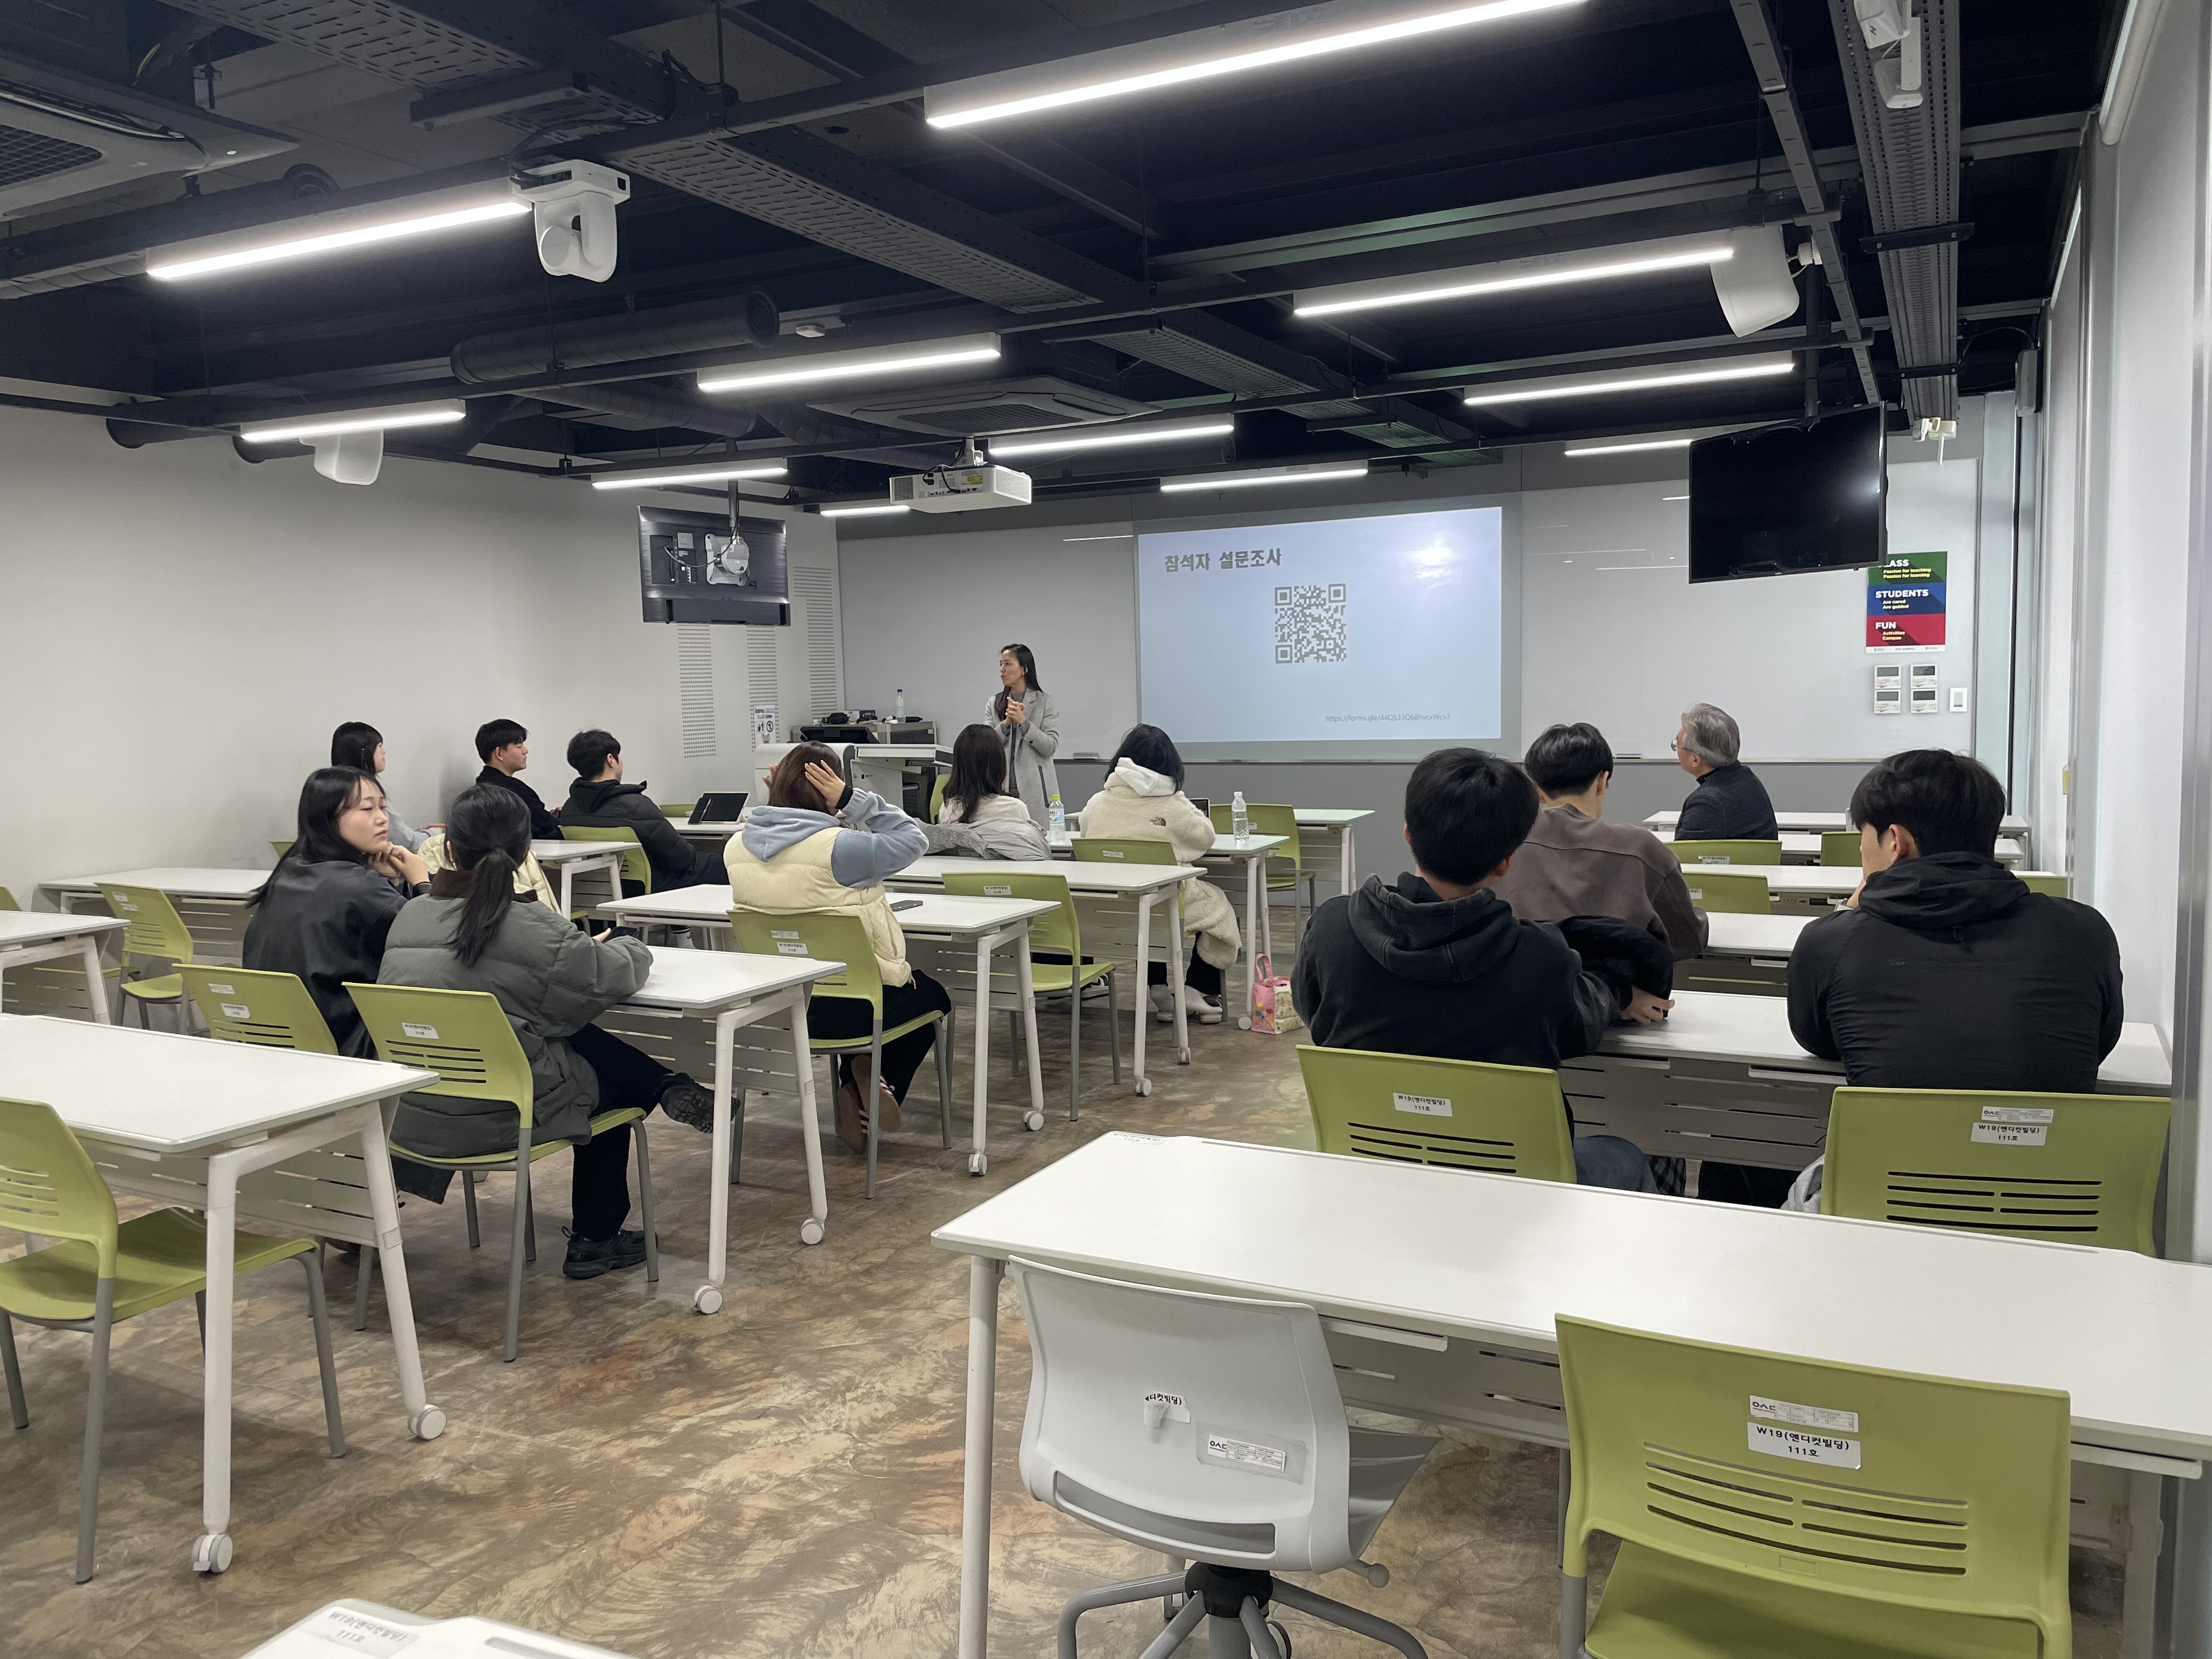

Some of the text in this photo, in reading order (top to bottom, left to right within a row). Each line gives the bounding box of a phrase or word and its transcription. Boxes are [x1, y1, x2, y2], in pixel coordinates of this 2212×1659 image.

[1164, 548, 1282, 573] 참석자 설문조사
[1878, 559, 1909, 568] ASS
[1875, 589, 1929, 599] STUDENTS
[1757, 1426, 1849, 1451] W19(엔디컷빌딩)
[1788, 1446, 1819, 1457] 111호
